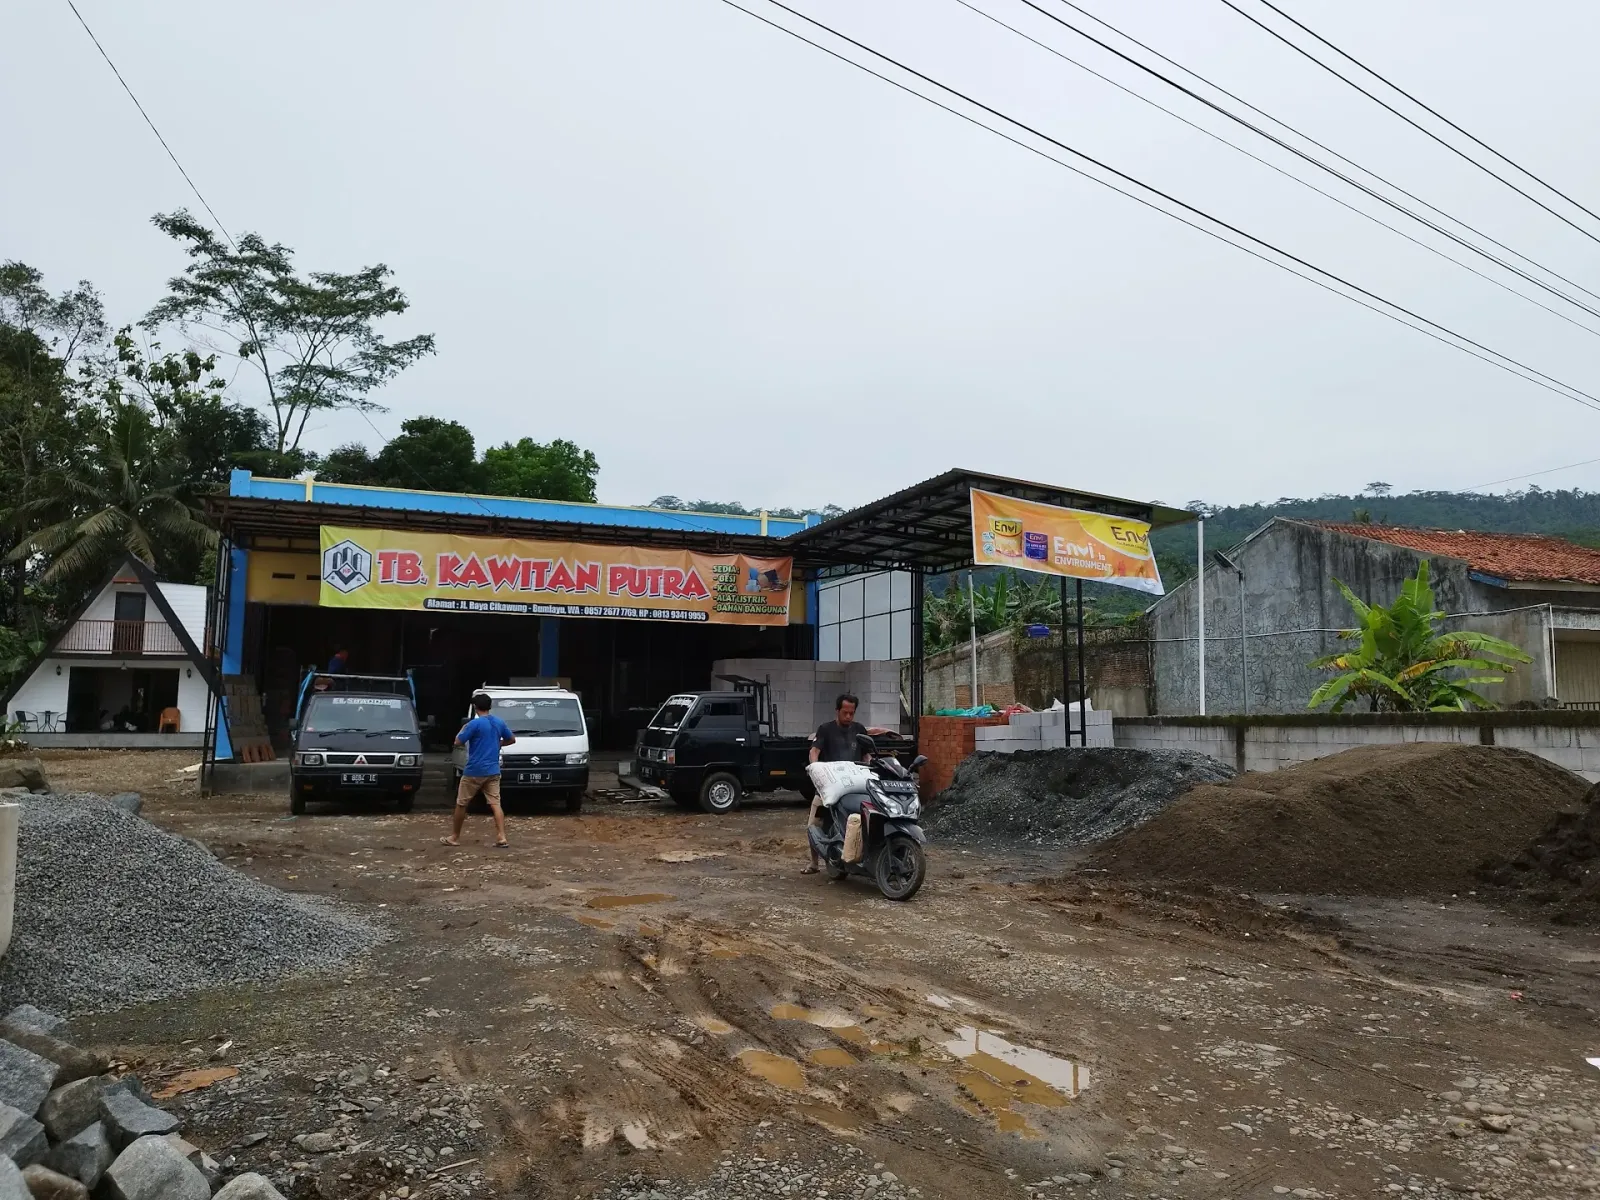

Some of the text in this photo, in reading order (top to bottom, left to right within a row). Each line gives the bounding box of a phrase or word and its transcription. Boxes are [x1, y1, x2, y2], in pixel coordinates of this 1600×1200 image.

[994, 520, 1018, 534] Envi
[1053, 536, 1096, 558] Envi
[1054, 555, 1113, 573] ENVIRONMENT
[376, 550, 711, 600] TB. KAWITAN PUTRA
[427, 599, 455, 609] Alamat
[469, 601, 488, 611] Raya
[489, 602, 527, 613] Cikawung
[567, 605, 580, 615] WA
[584, 606, 602, 616] 0857
[603, 607, 620, 616] 2677
[639, 609, 649, 618] HP
[653, 610, 669, 619] 0813
[670, 611, 687, 619] 9341
[737, 596, 767, 604] LISTRIK
